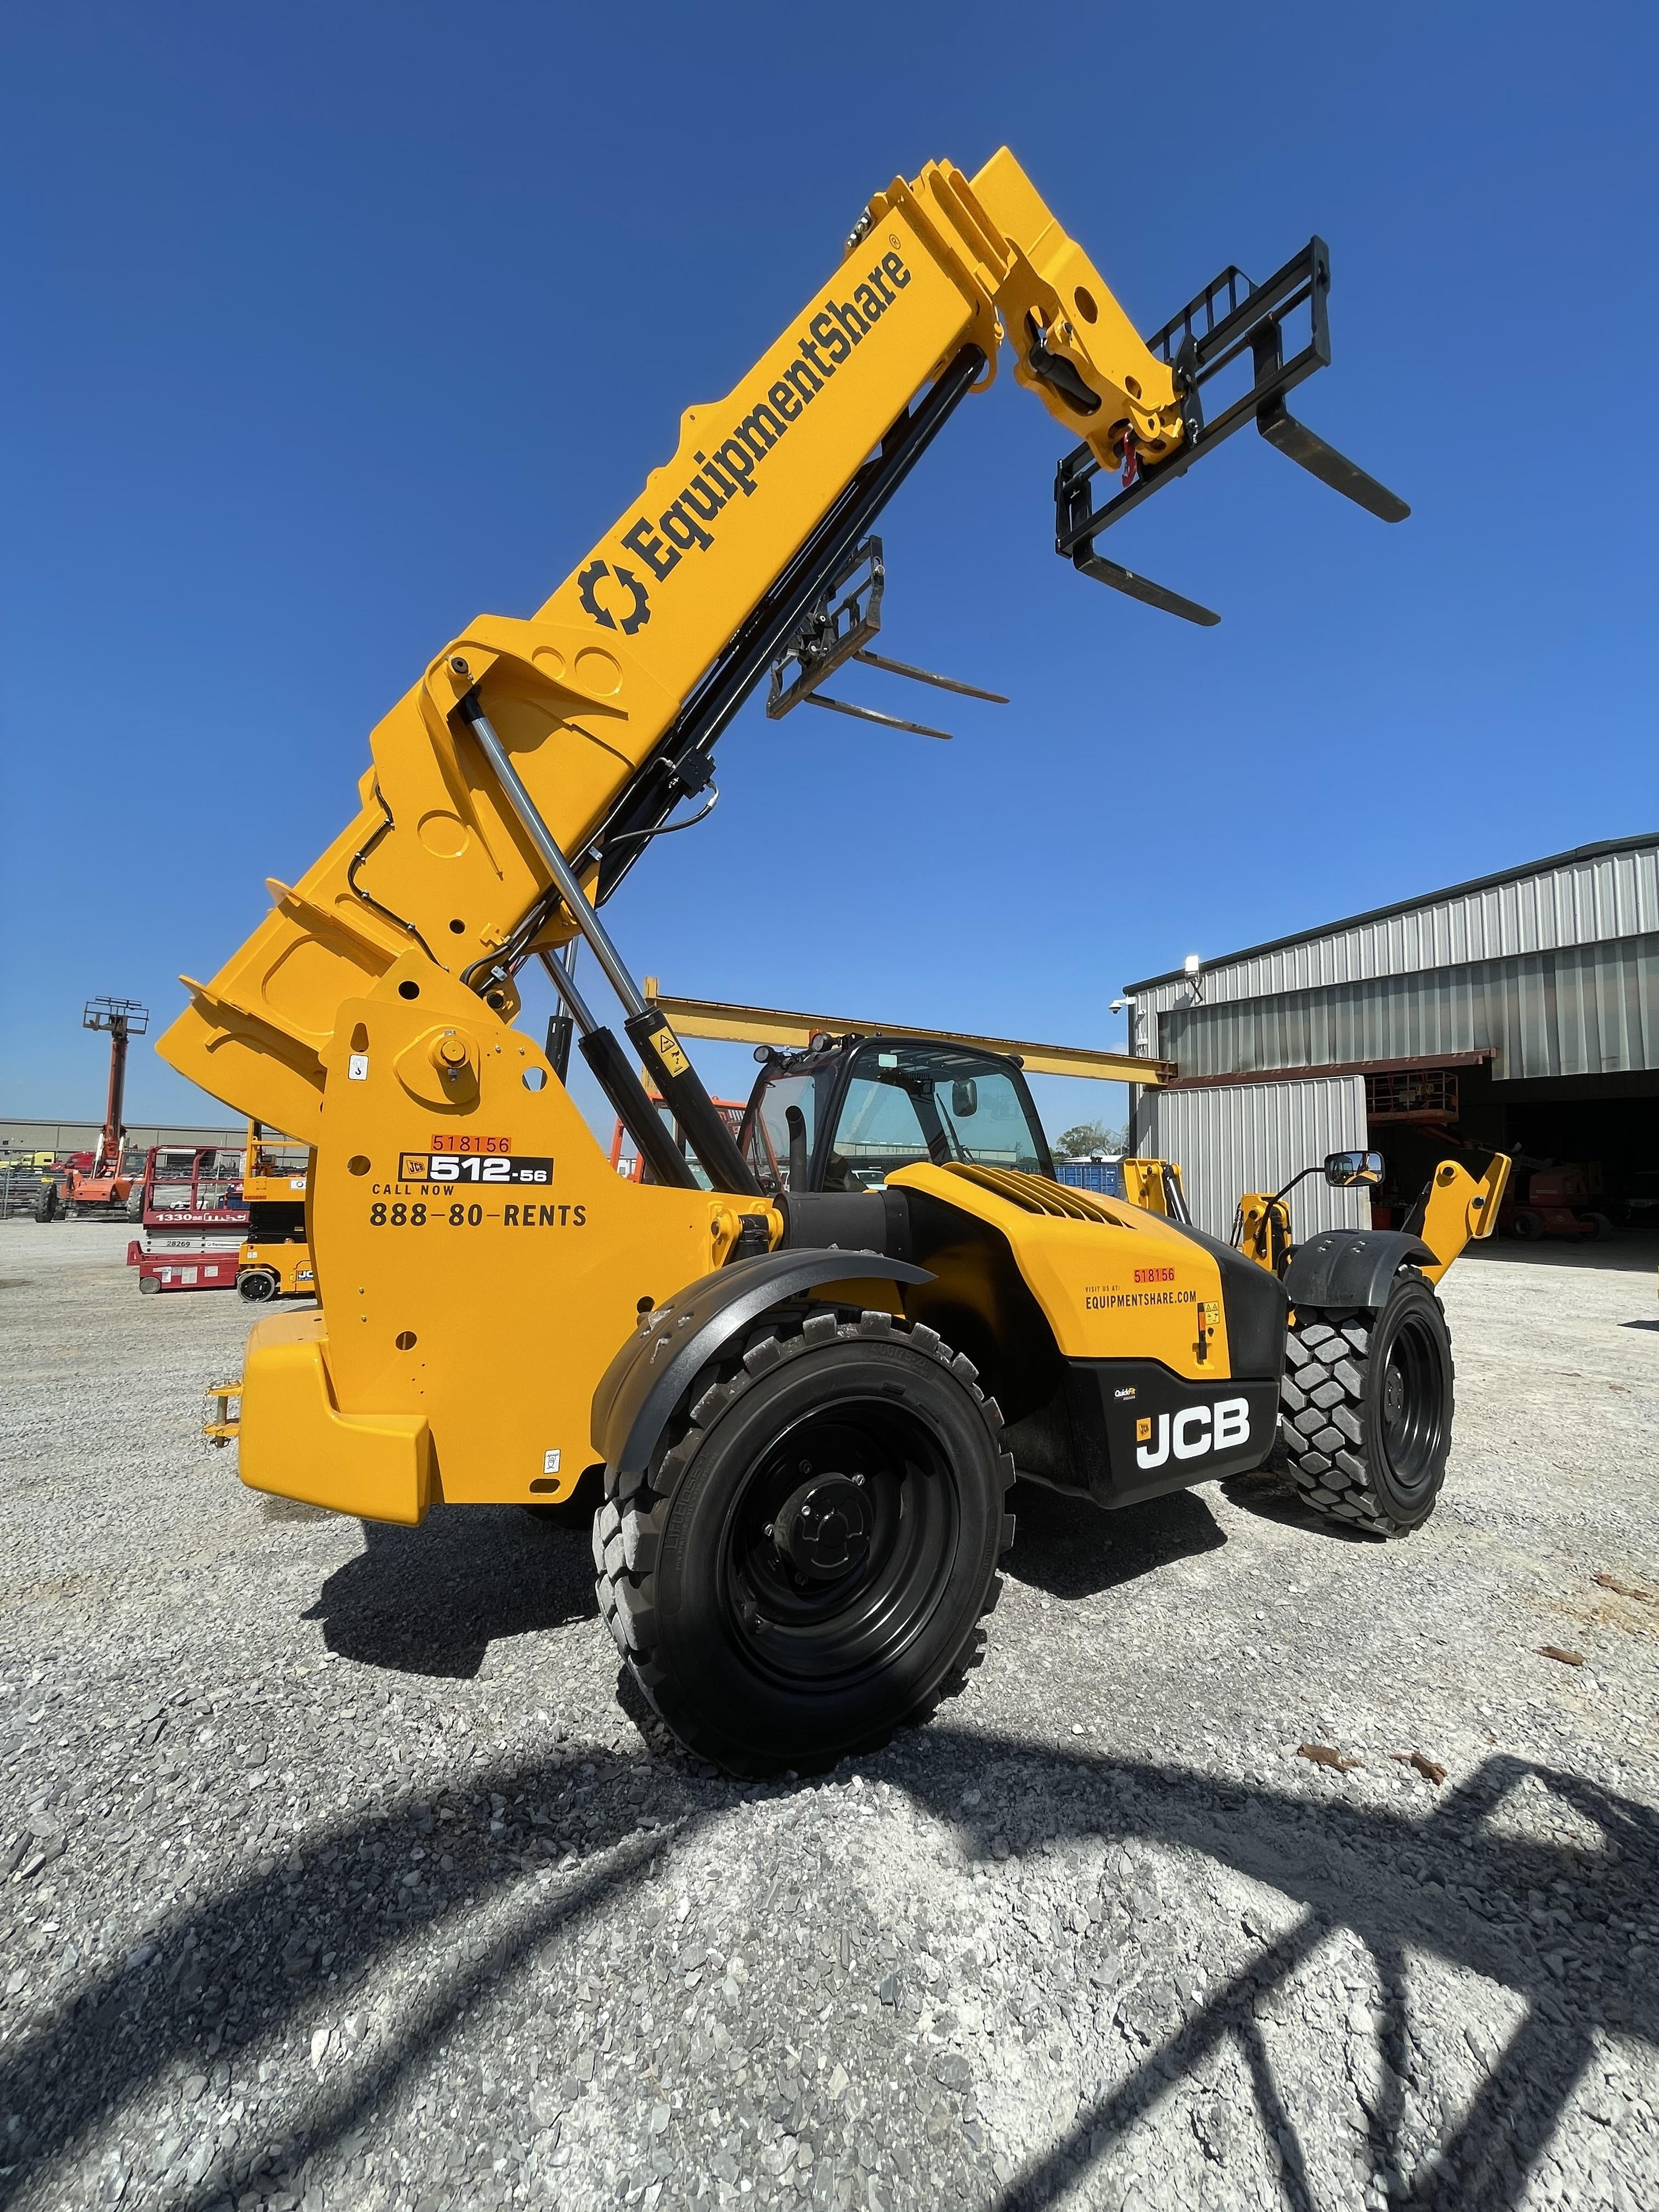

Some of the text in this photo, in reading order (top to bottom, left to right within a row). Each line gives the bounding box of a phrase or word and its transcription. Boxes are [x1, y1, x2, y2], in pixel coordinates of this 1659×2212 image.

[433, 1136, 510, 1152] 518156
[409, 1161, 424, 1173] JCB
[372, 1184, 454, 1196] CALL NOW
[369, 1203, 586, 1226] 888-80-RENTS
[1135, 1268, 1175, 1283] 518156
[1086, 1290, 1197, 1310] EQUIPMENTSHARE.COM
[1137, 1398, 1250, 1470] JCB
